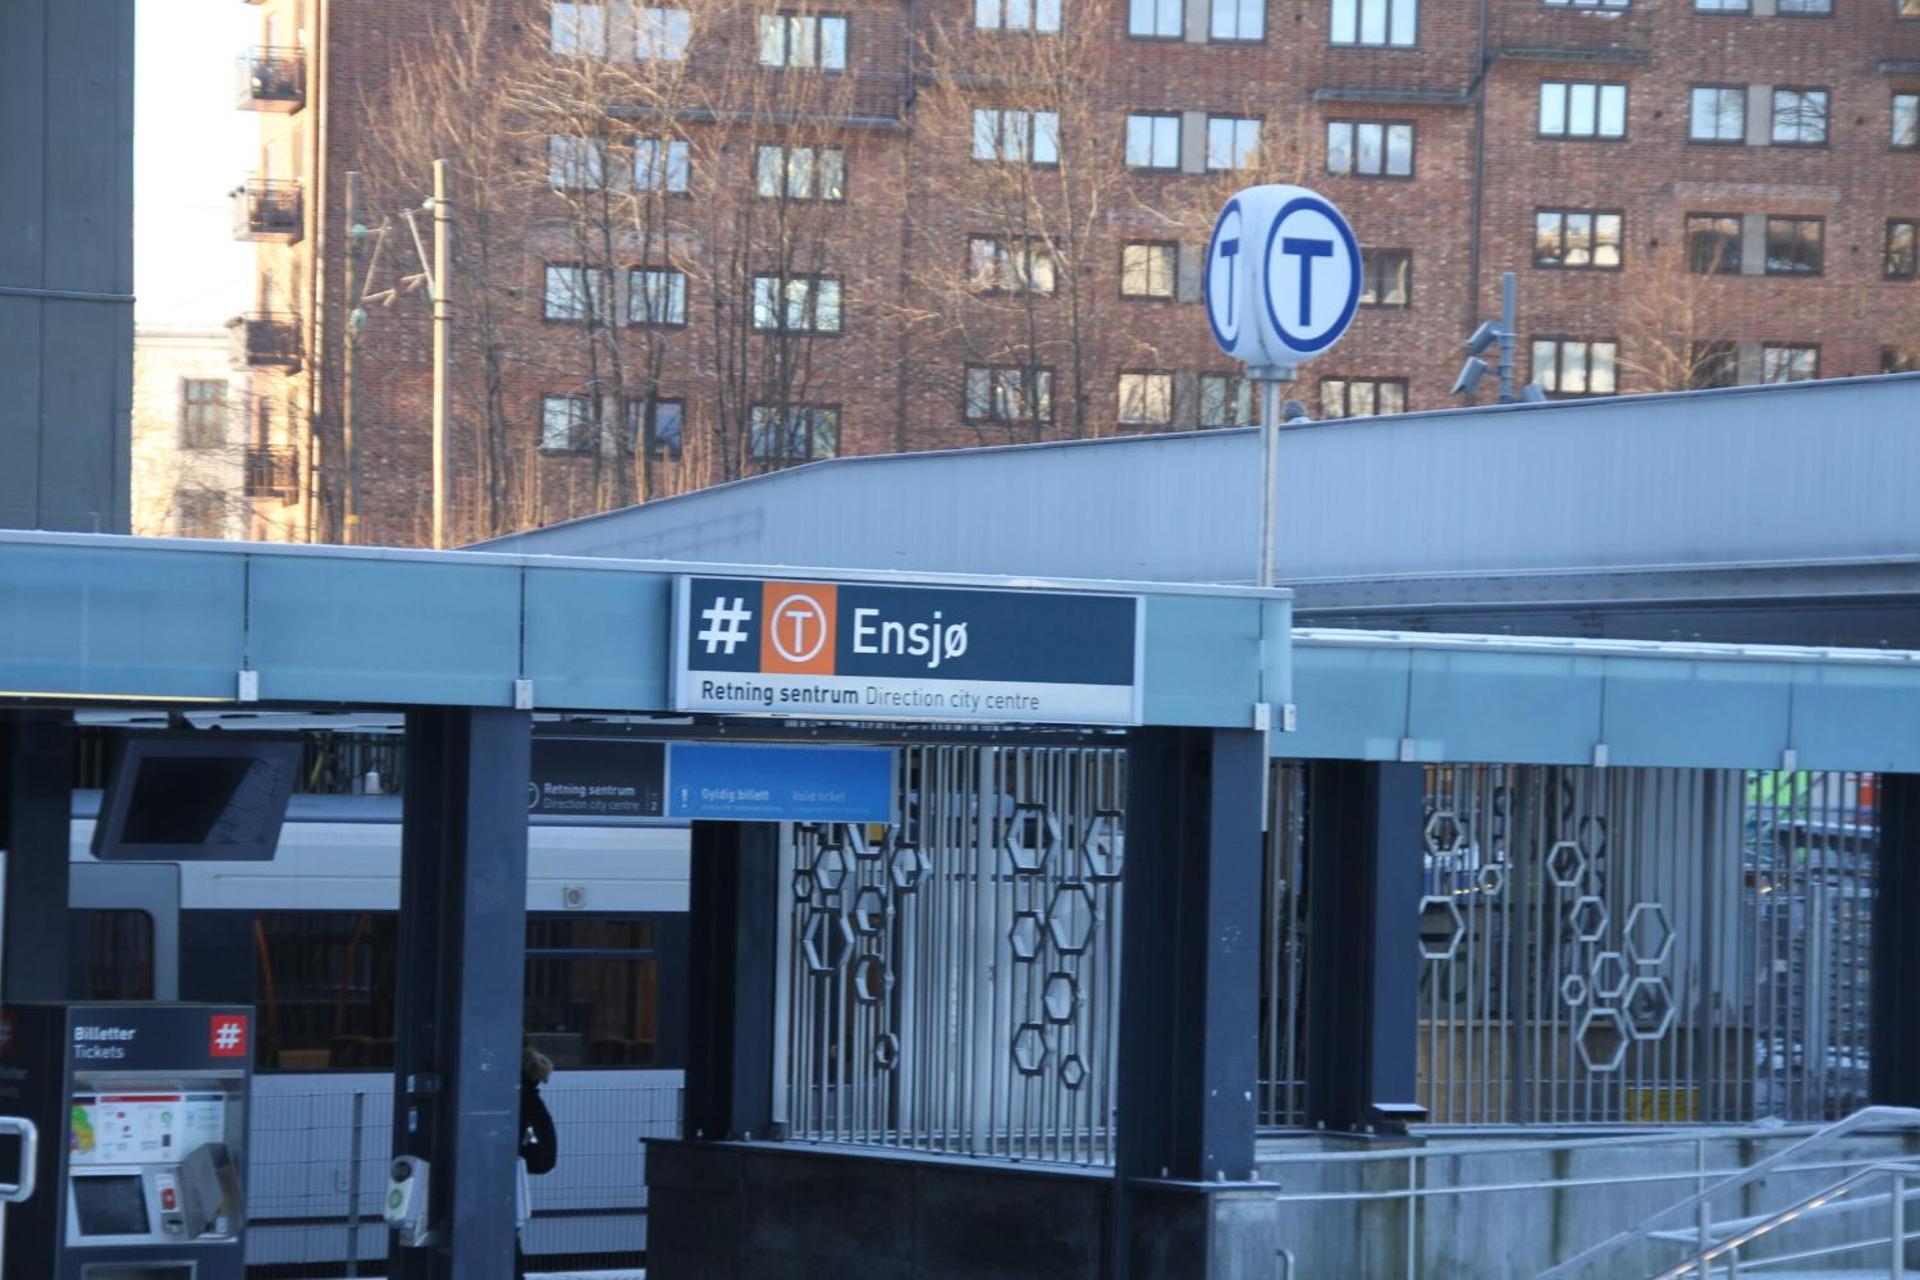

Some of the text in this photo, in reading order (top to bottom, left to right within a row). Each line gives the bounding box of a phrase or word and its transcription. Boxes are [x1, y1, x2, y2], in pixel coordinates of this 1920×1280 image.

[1220, 238, 1239, 327] T
[1282, 237, 1334, 327] T
[785, 611, 814, 653] T
[852, 607, 967, 669] Ensjø
[702, 680, 1041, 713] Retning sentrum Direction city centre
[73, 1045, 125, 1059] Tickets
[74, 1026, 136, 1041] Billetter
